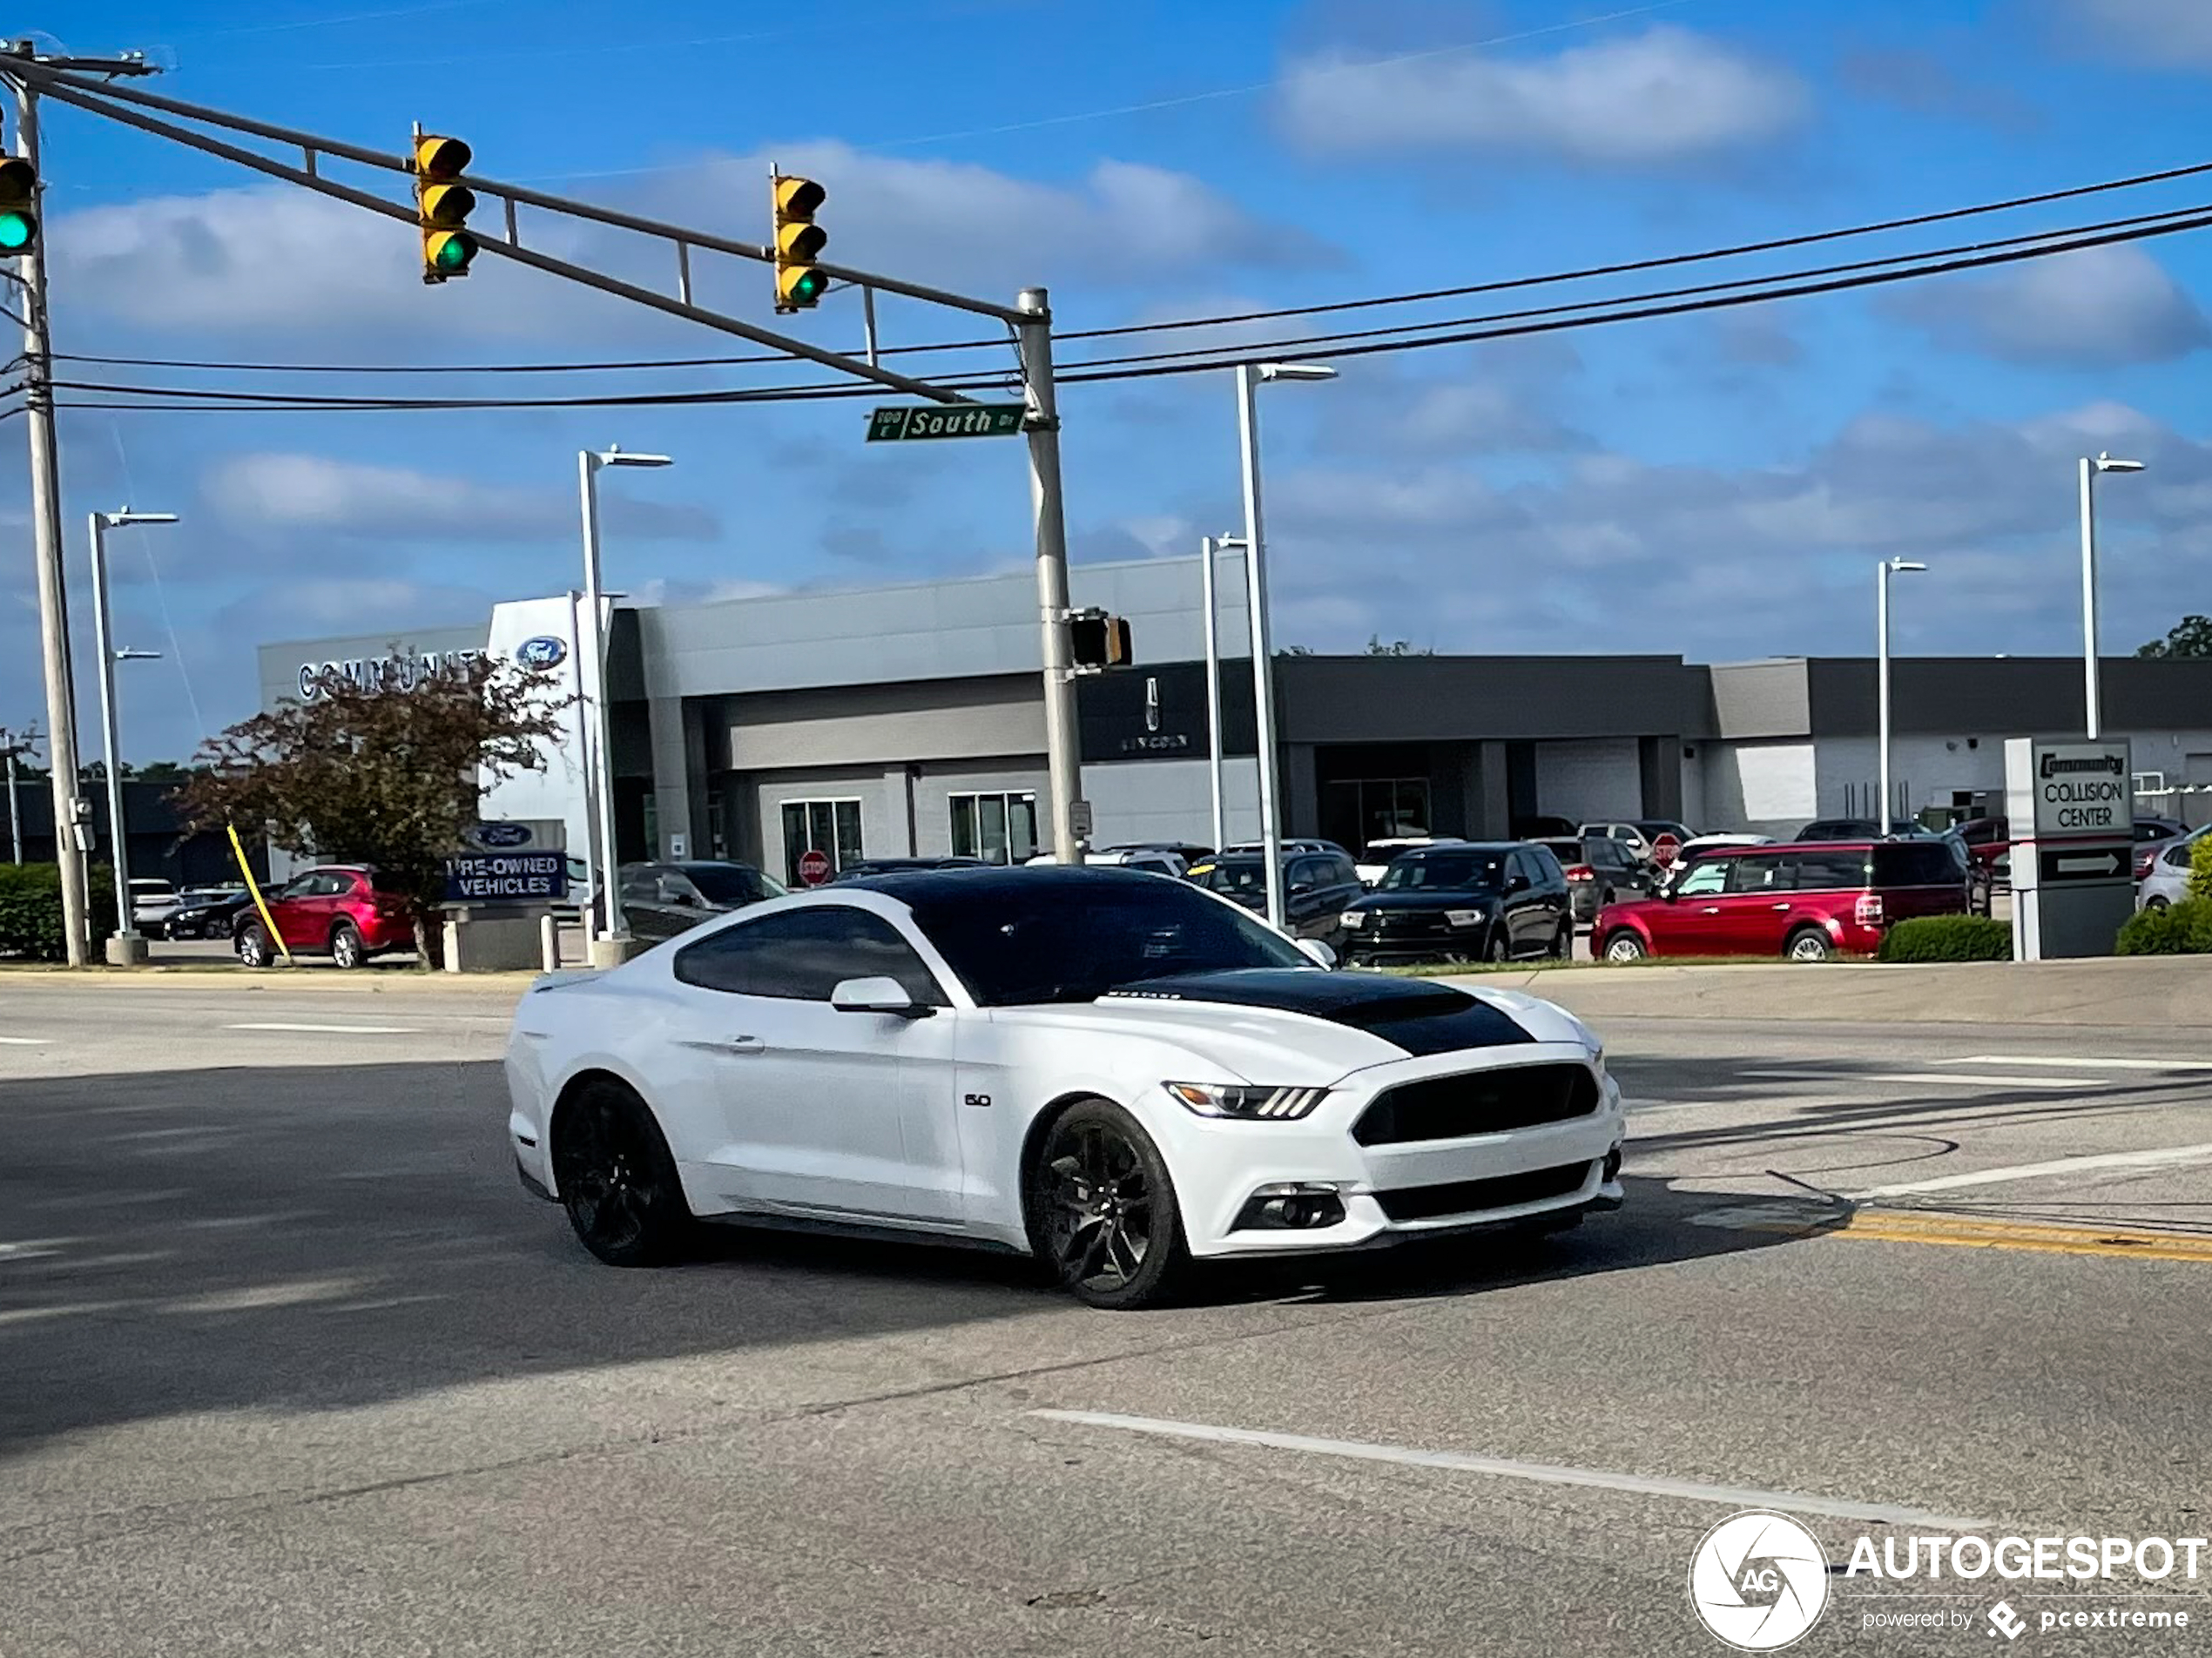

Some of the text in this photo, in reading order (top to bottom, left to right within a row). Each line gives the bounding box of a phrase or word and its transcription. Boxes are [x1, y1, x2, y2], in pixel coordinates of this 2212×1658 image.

[911, 410, 992, 435] South
[2045, 781, 2122, 803] COLLISION
[2058, 806, 2113, 827] CENTER
[803, 861, 828, 875] STOP
[458, 876, 551, 896] VEHICLES
